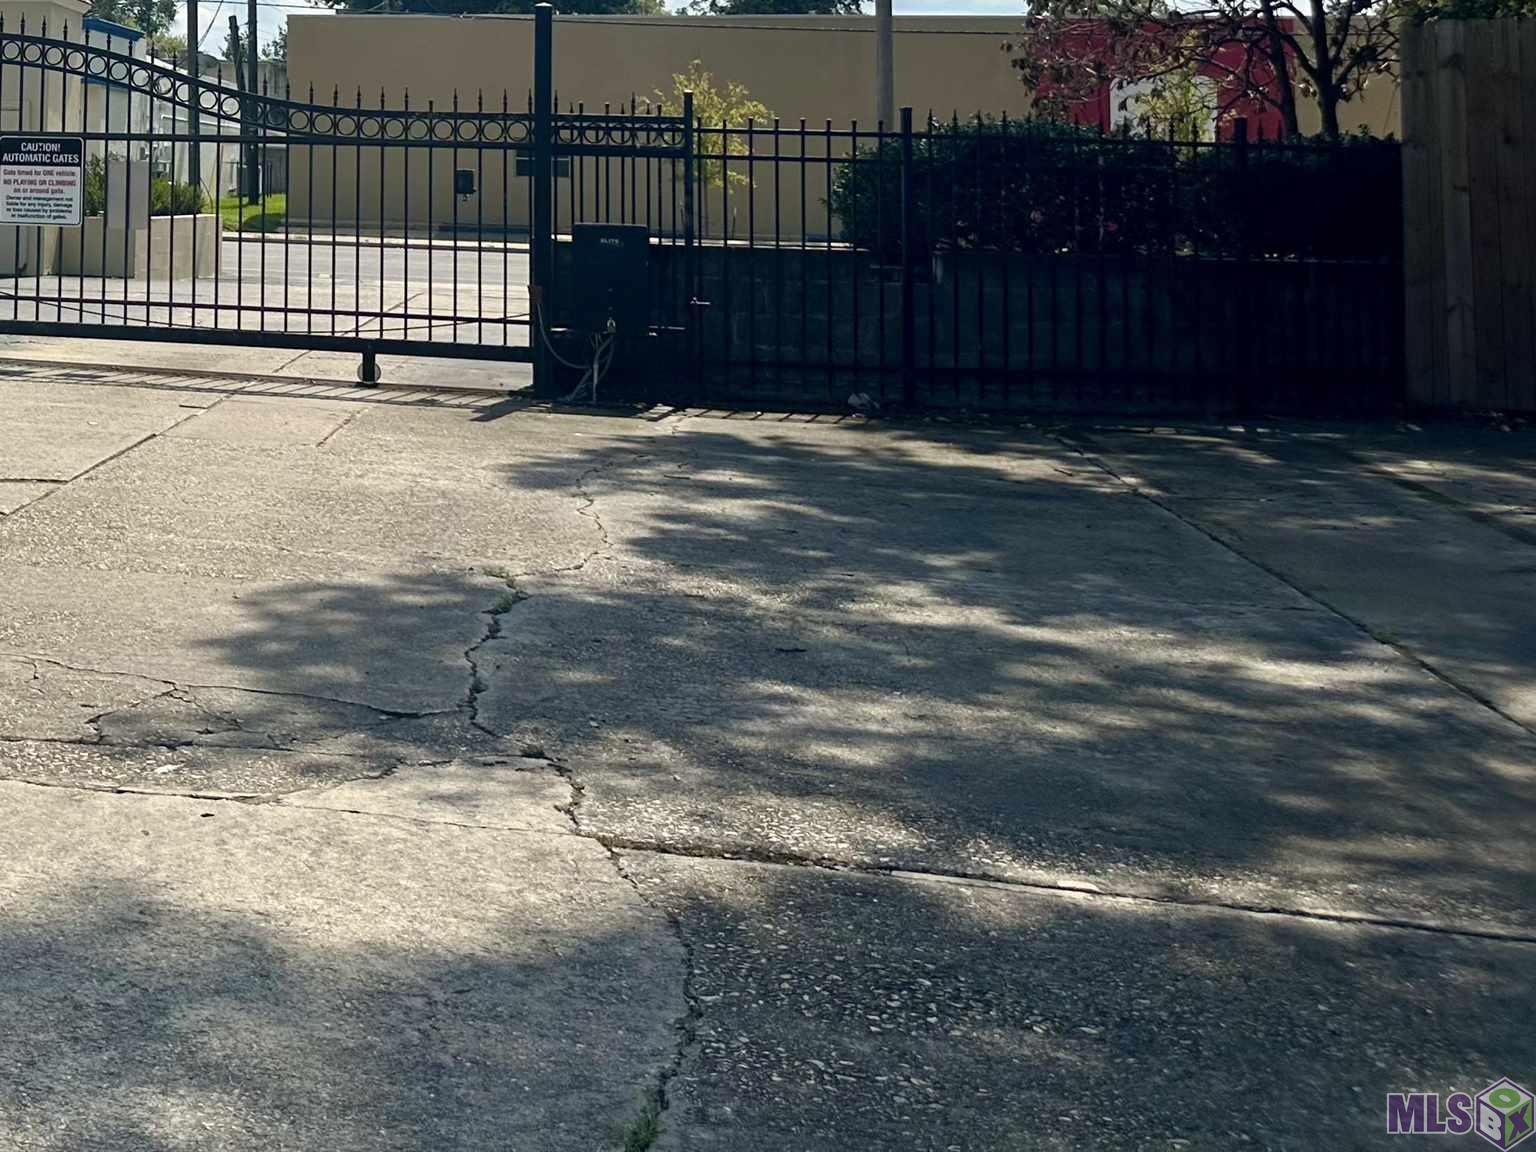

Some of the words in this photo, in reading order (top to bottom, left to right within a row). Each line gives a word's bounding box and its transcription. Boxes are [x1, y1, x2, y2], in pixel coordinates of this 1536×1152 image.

[21, 142, 61, 152] CAUTION!
[3, 152, 51, 163] AUTOMATIC
[52, 153, 79, 163] GATES
